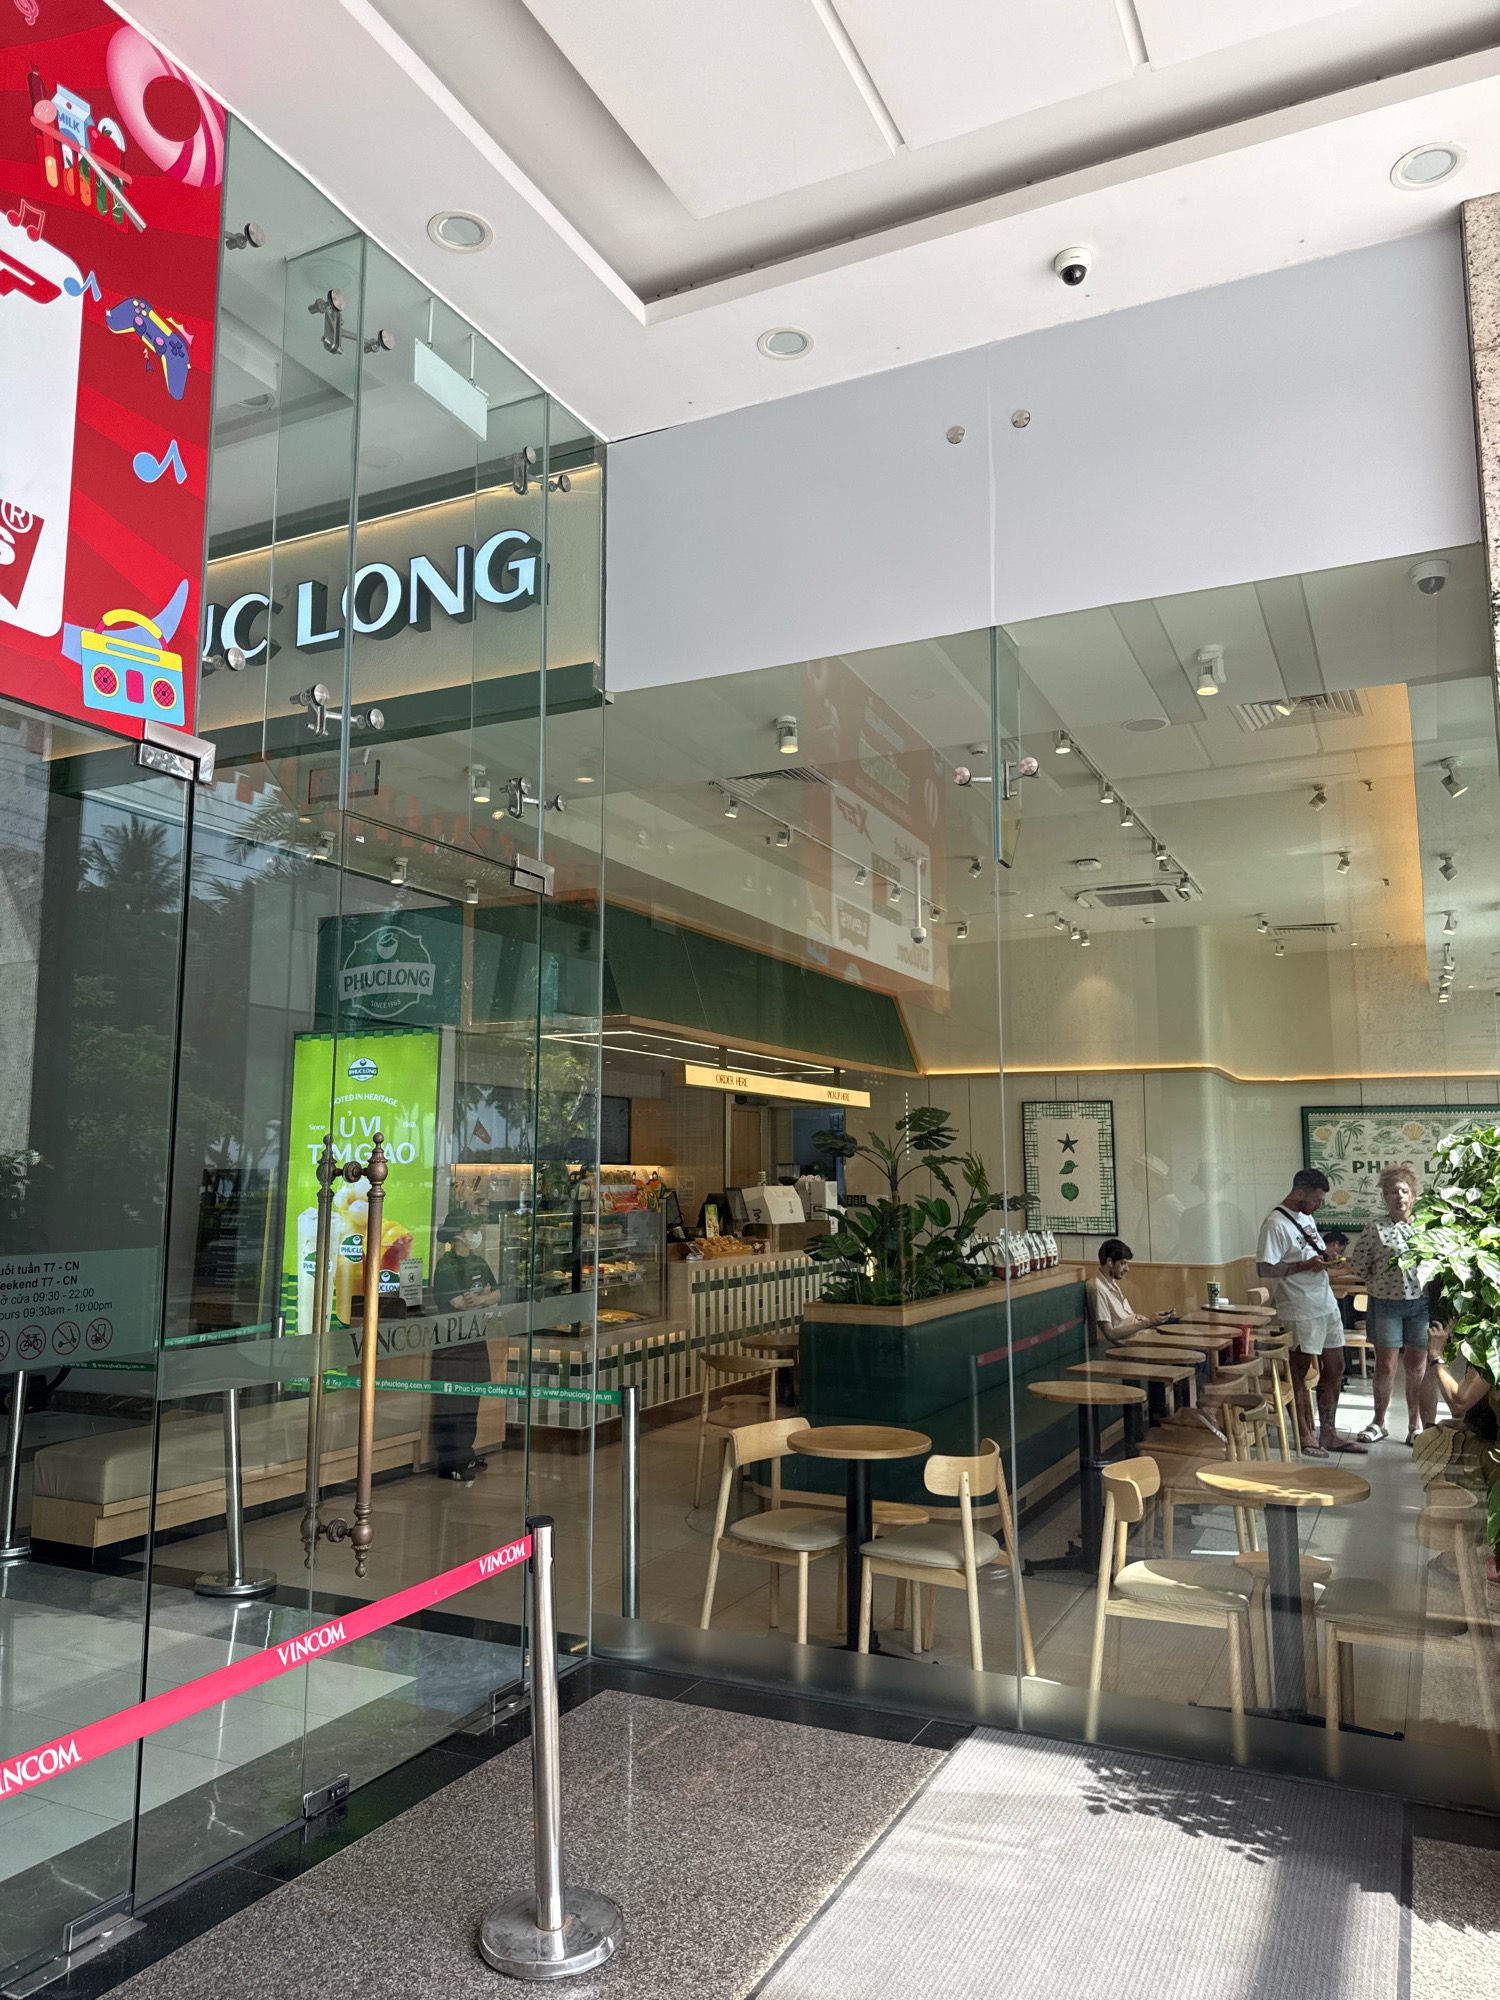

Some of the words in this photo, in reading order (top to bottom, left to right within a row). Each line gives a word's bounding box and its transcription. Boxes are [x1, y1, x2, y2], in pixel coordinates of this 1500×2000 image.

[60, 113, 80, 133] MILK
[296, 529, 536, 647] LONG
[716, 1073, 734, 1086] ORDER
[736, 1076, 748, 1088] HERE
[364, 1093, 399, 1107] HERITAGE
[307, 1143, 352, 1165] TM
[354, 1142, 416, 1165] GAO
[0, 1263, 14, 1275] uối
[17, 1262, 40, 1274] tuần
[43, 1263, 56, 1273] T7
[64, 1261, 80, 1271] CN
[0, 1278, 38, 1290] eekend
[41, 1277, 54, 1287] T7
[62, 1275, 78, 1286] CN
[0, 1295, 8, 1305] ở
[11, 1293, 30, 1304] cửa
[32, 1291, 60, 1302] 09:30
[68, 1288, 94, 1299] 22:00
[0, 1310, 20, 1320] ours
[23, 1305, 65, 1318] 09:30am
[74, 1301, 113, 1313] 10:00pm
[349, 1321, 440, 1358] VNCOM
[454, 1384, 470, 1392] Phuc
[471, 1385, 486, 1394] Long
[488, 1386, 508, 1394] Coffee
[515, 1388, 526, 1396] Tea
[479, 1541, 525, 1575] VINCOM
[277, 1621, 346, 1666] VINCOM
